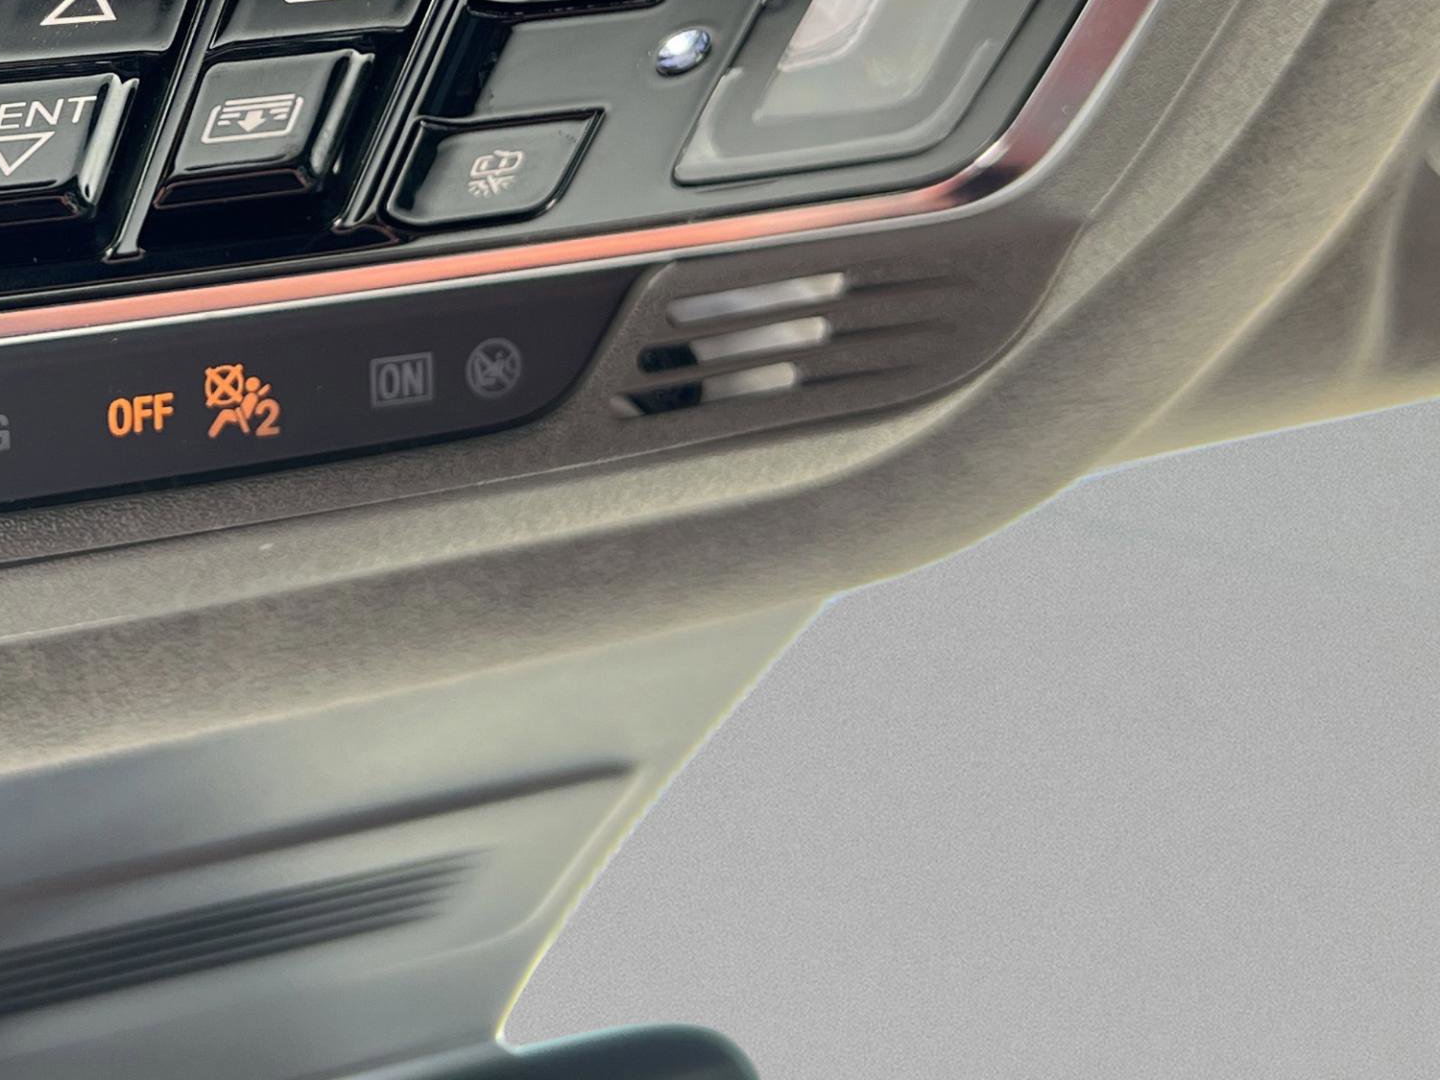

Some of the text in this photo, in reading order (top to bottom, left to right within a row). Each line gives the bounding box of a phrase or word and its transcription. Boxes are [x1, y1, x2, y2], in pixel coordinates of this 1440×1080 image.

[378, 360, 423, 400] ON
[107, 392, 174, 437] OFF
[255, 398, 280, 436] 2
